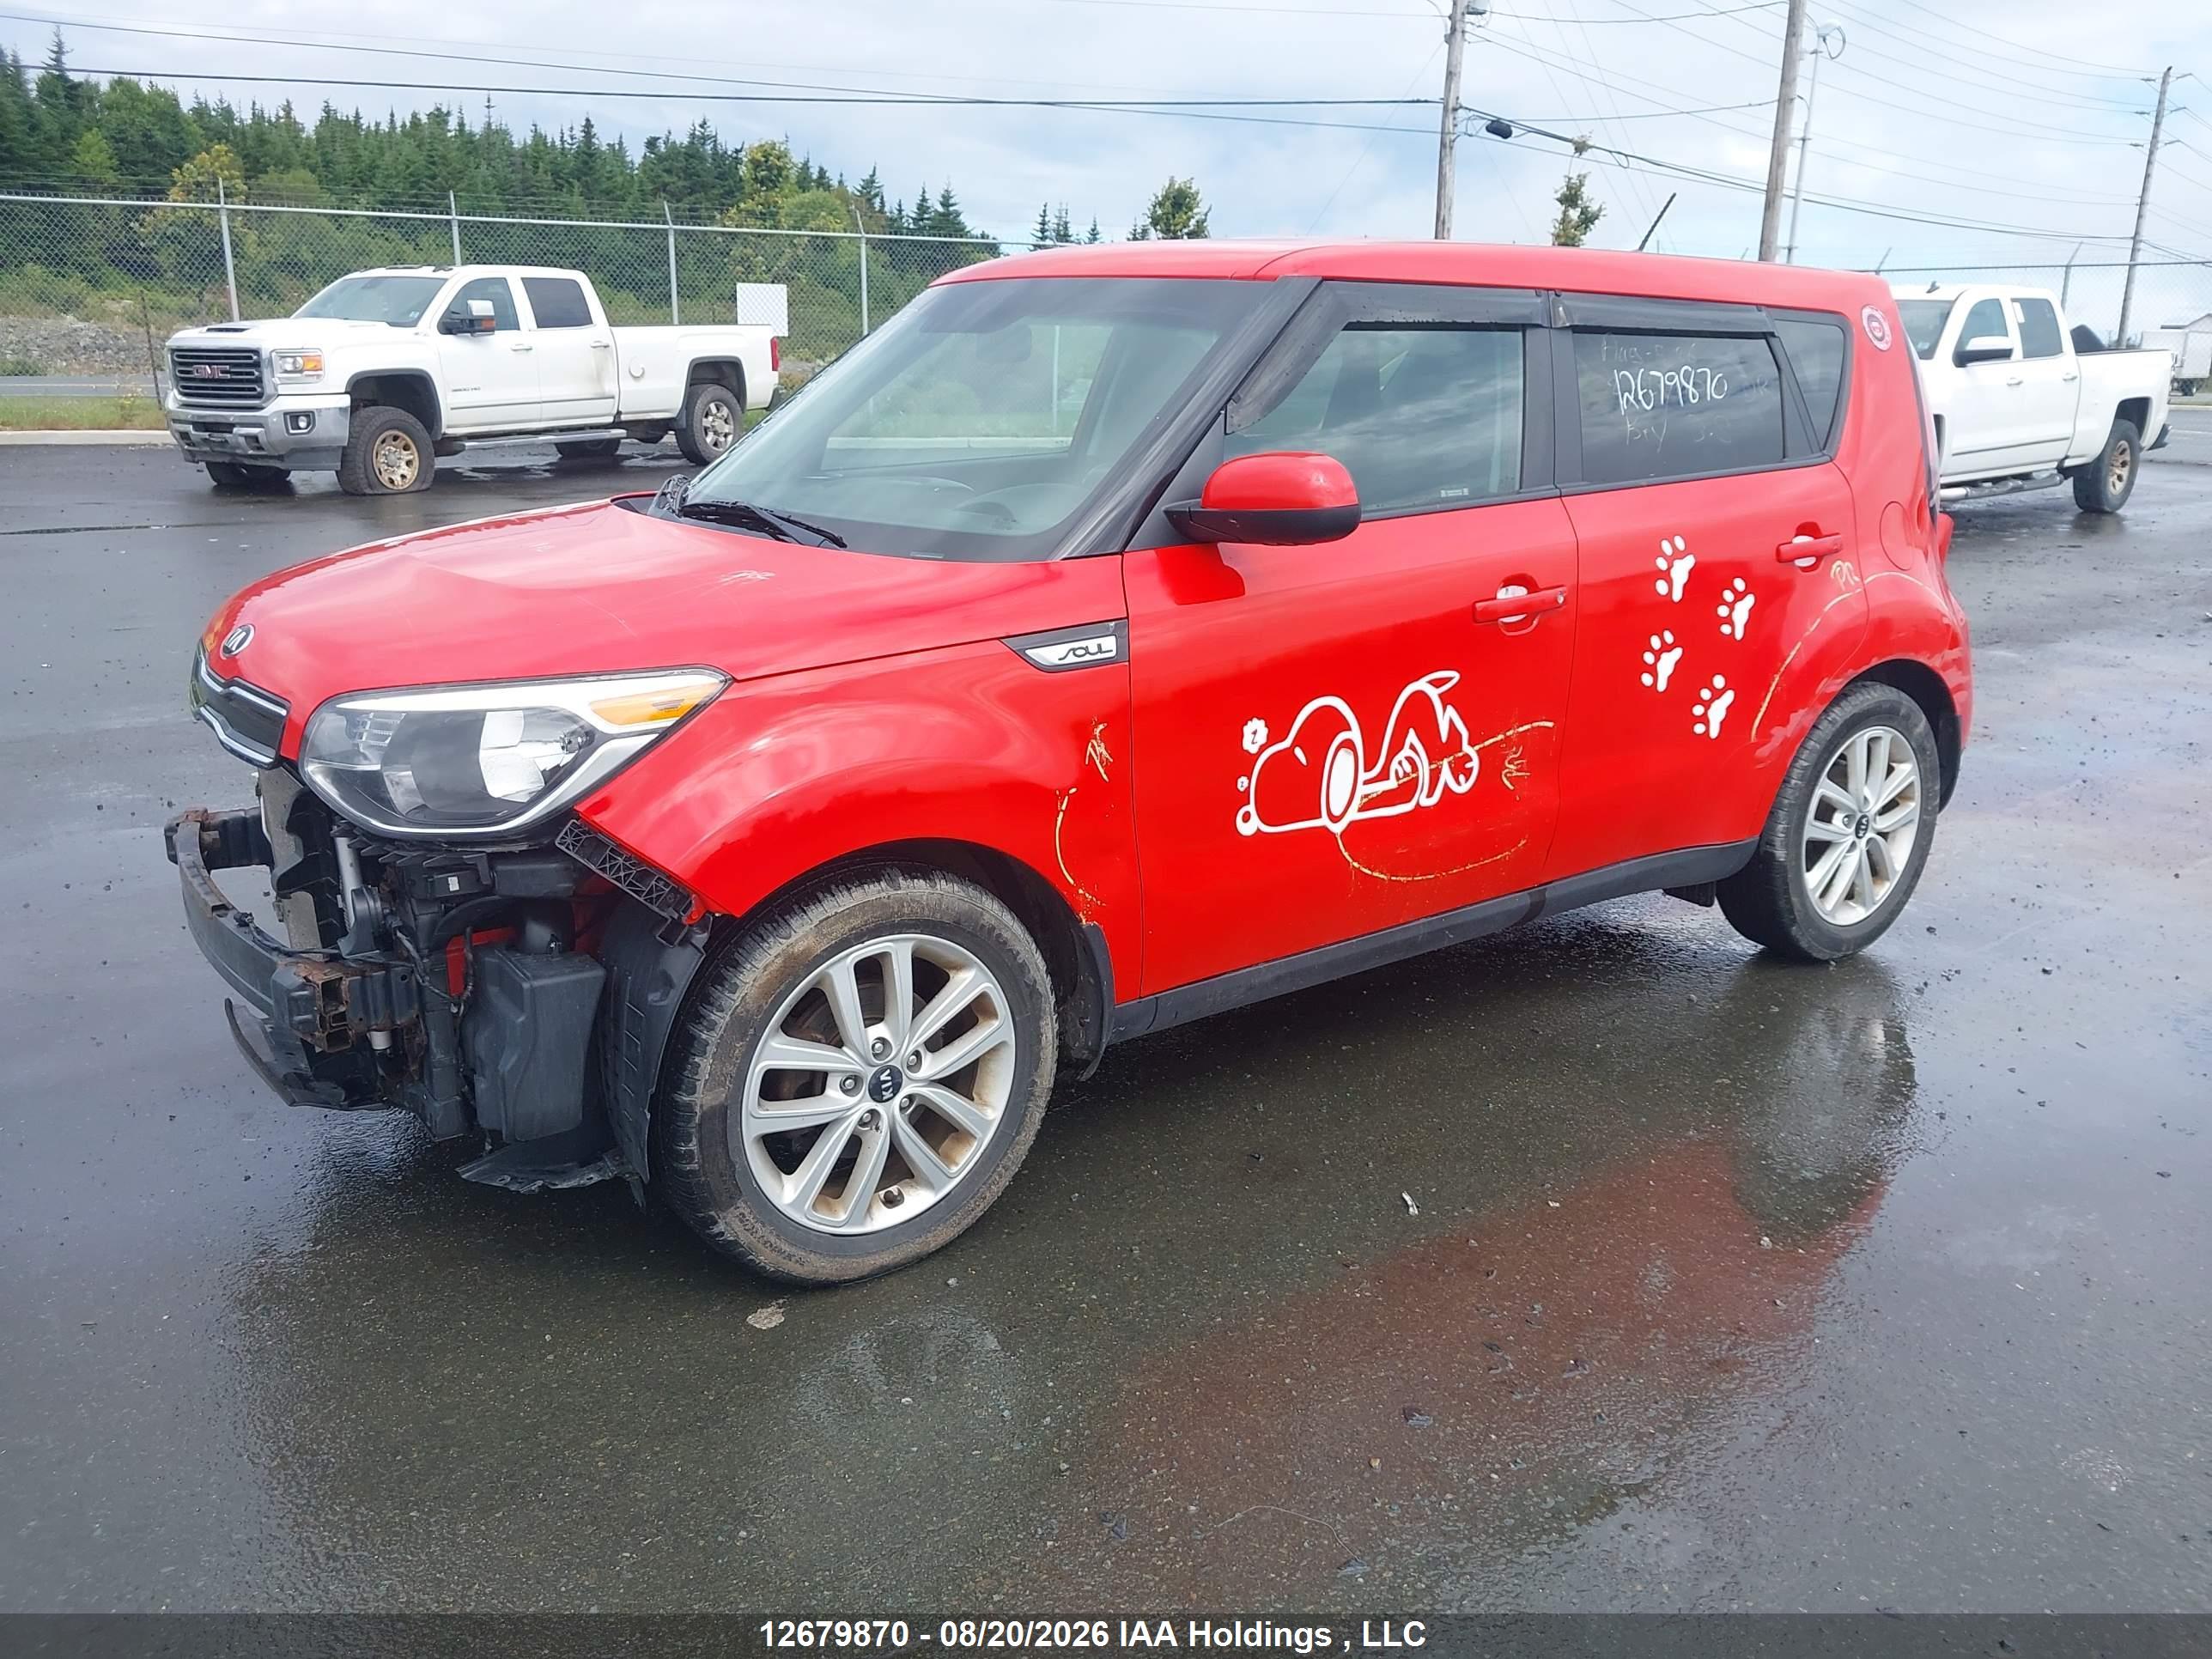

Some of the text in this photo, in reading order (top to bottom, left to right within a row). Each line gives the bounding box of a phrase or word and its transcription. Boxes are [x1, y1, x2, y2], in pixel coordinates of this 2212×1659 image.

[192, 365, 230, 379] GMC
[1613, 365, 1729, 416] 12679870
[1057, 643, 1114, 661] SOUL
[1856, 817, 1869, 837] KIA
[879, 1068, 894, 1100] KIA
